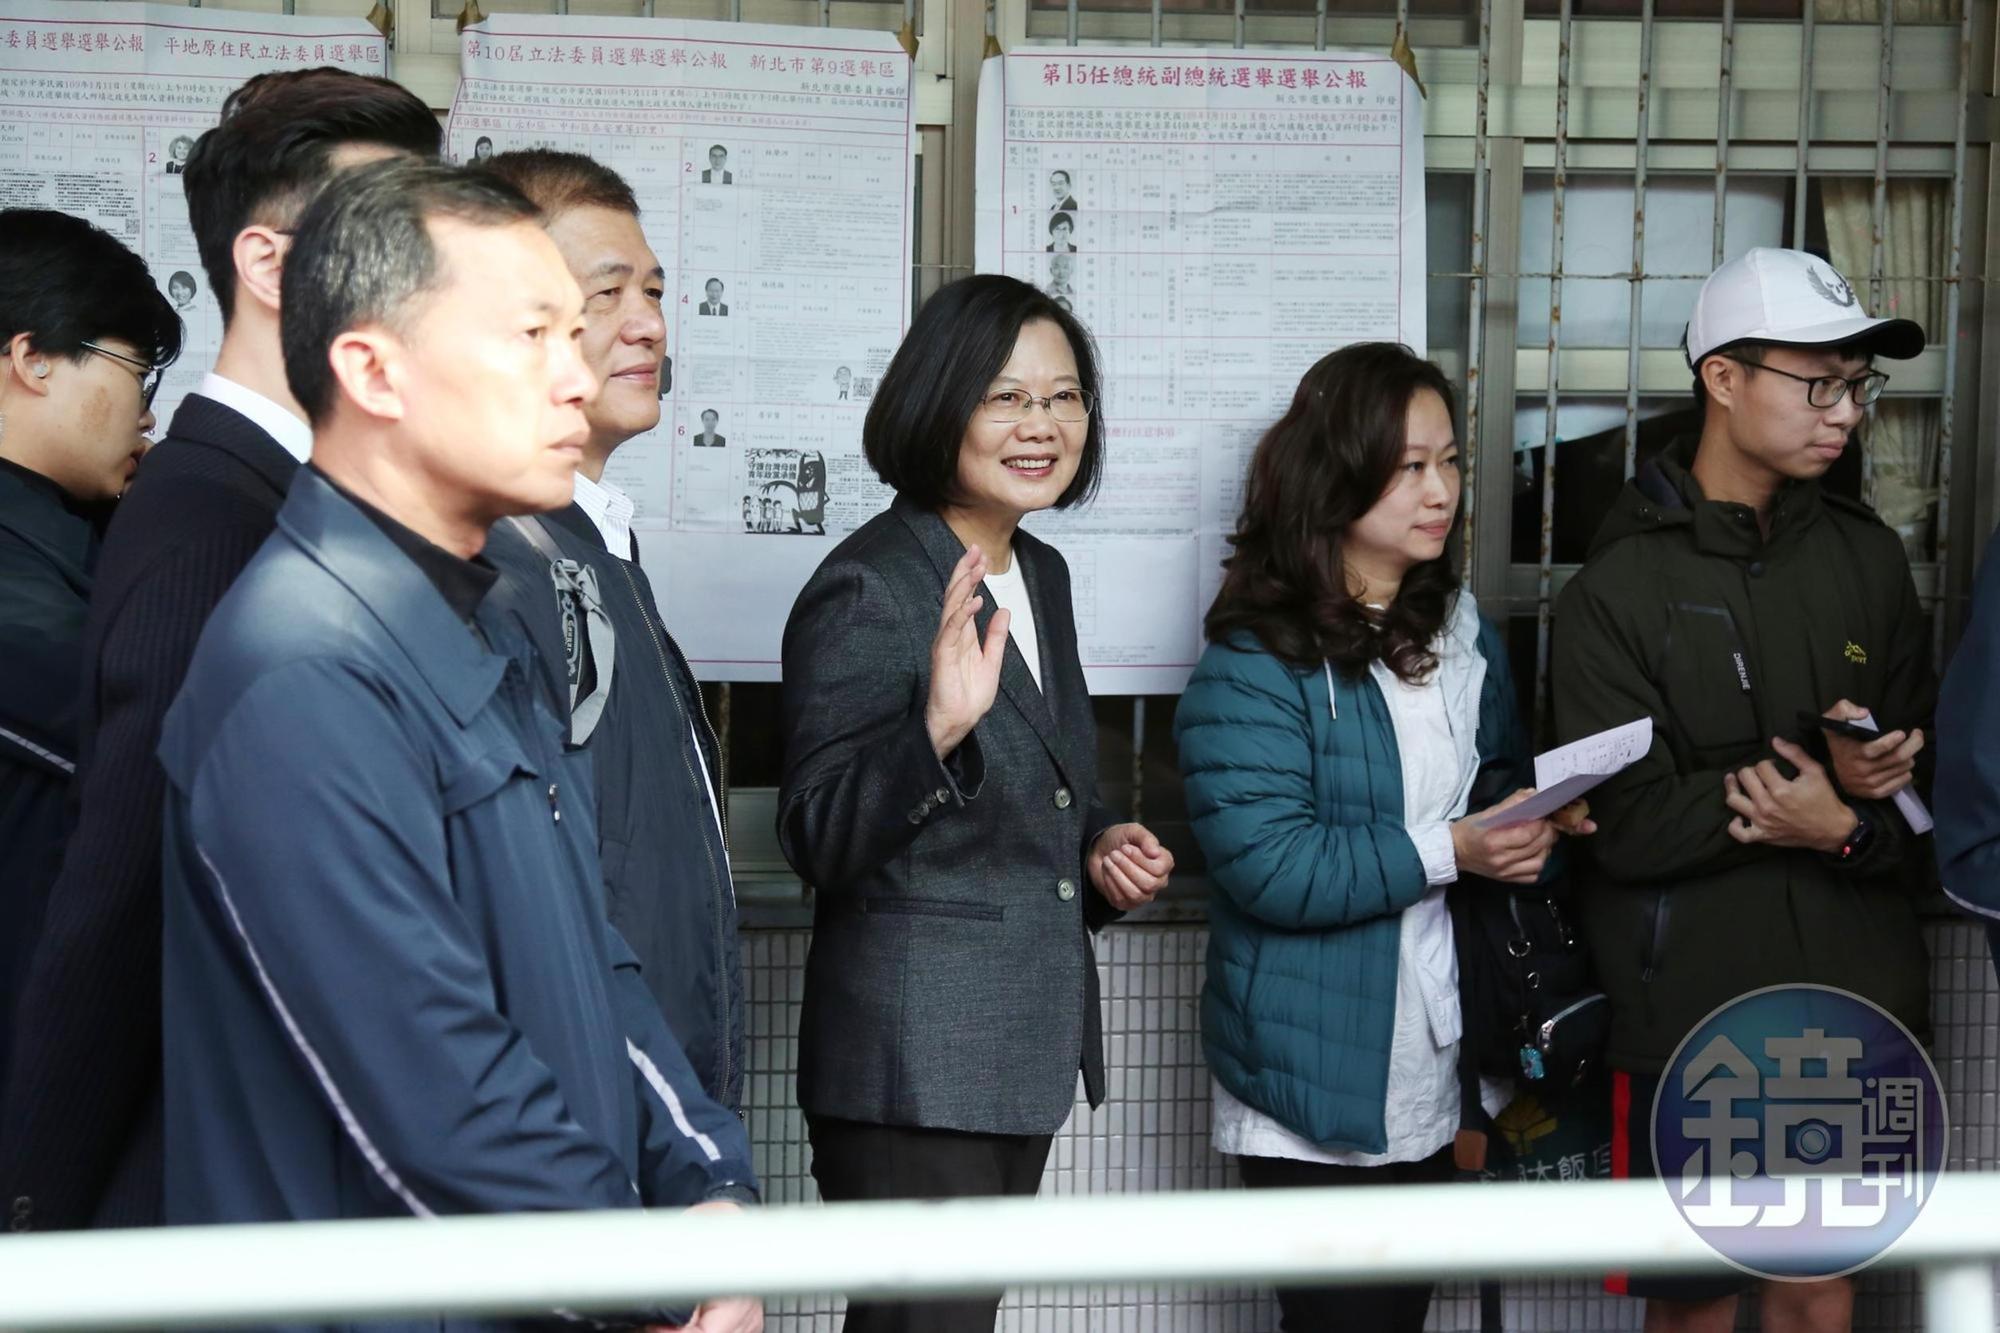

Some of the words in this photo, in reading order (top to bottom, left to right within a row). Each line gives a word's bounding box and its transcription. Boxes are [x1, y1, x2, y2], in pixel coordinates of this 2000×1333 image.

[0, 30, 144, 53] 委員選舉選舉公報
[164, 37, 381, 63] 平地原住民立法委員選舉區
[467, 39, 728, 70] 第10屆立法委員選舉選舉公報
[750, 54, 896, 79] 新北市第9選舉區
[1043, 63, 1368, 90] 第15任總統副總統選舉選舉公報
[148, 152, 157, 164] 2
[685, 162, 692, 172] 2
[681, 294, 689, 304] 4
[678, 425, 686, 436] 6
